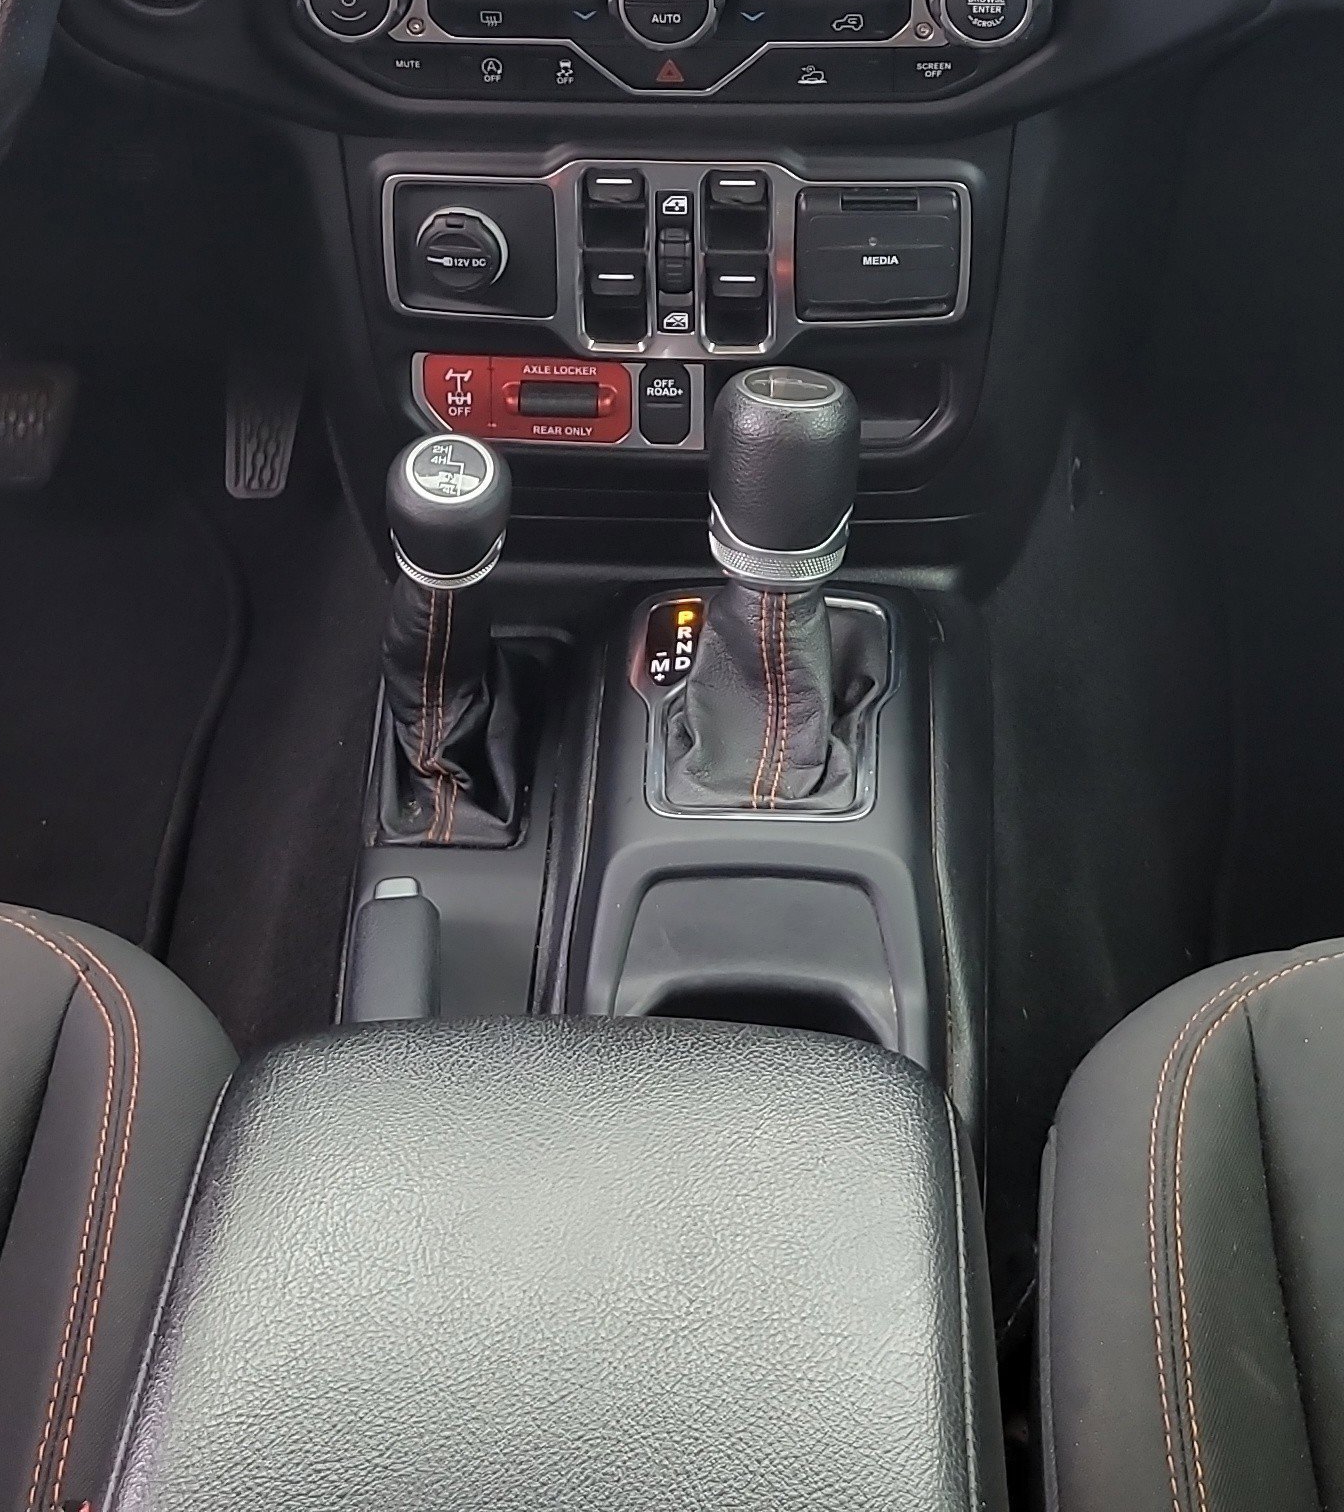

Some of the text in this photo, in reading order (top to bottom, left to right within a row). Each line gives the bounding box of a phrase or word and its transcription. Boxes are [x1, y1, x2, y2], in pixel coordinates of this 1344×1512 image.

[972, 6, 1002, 14] ENTER
[651, 14, 681, 23] AUTO
[972, 18, 1001, 27] SCROLL
[395, 60, 421, 68] MUTE
[916, 62, 952, 71] SCREEN
[924, 70, 943, 78] OFF
[483, 75, 502, 83] OFF
[557, 76, 574, 85] OFF
[454, 258, 487, 267] 12V DC
[862, 255, 899, 265] MEDIA
[522, 365, 597, 376] AXLE LOCKER
[653, 379, 675, 388] OFF
[646, 387, 684, 396] ROAD+
[447, 407, 472, 417] OFF
[532, 425, 593, 437] REAR ONLY
[432, 445, 449, 454] 2H
[430, 455, 447, 464] 4H
[678, 610, 694, 626] P
[677, 626, 693, 640] R
[676, 640, 693, 655] N
[650, 658, 670, 673] M
[674, 656, 691, 670] D
